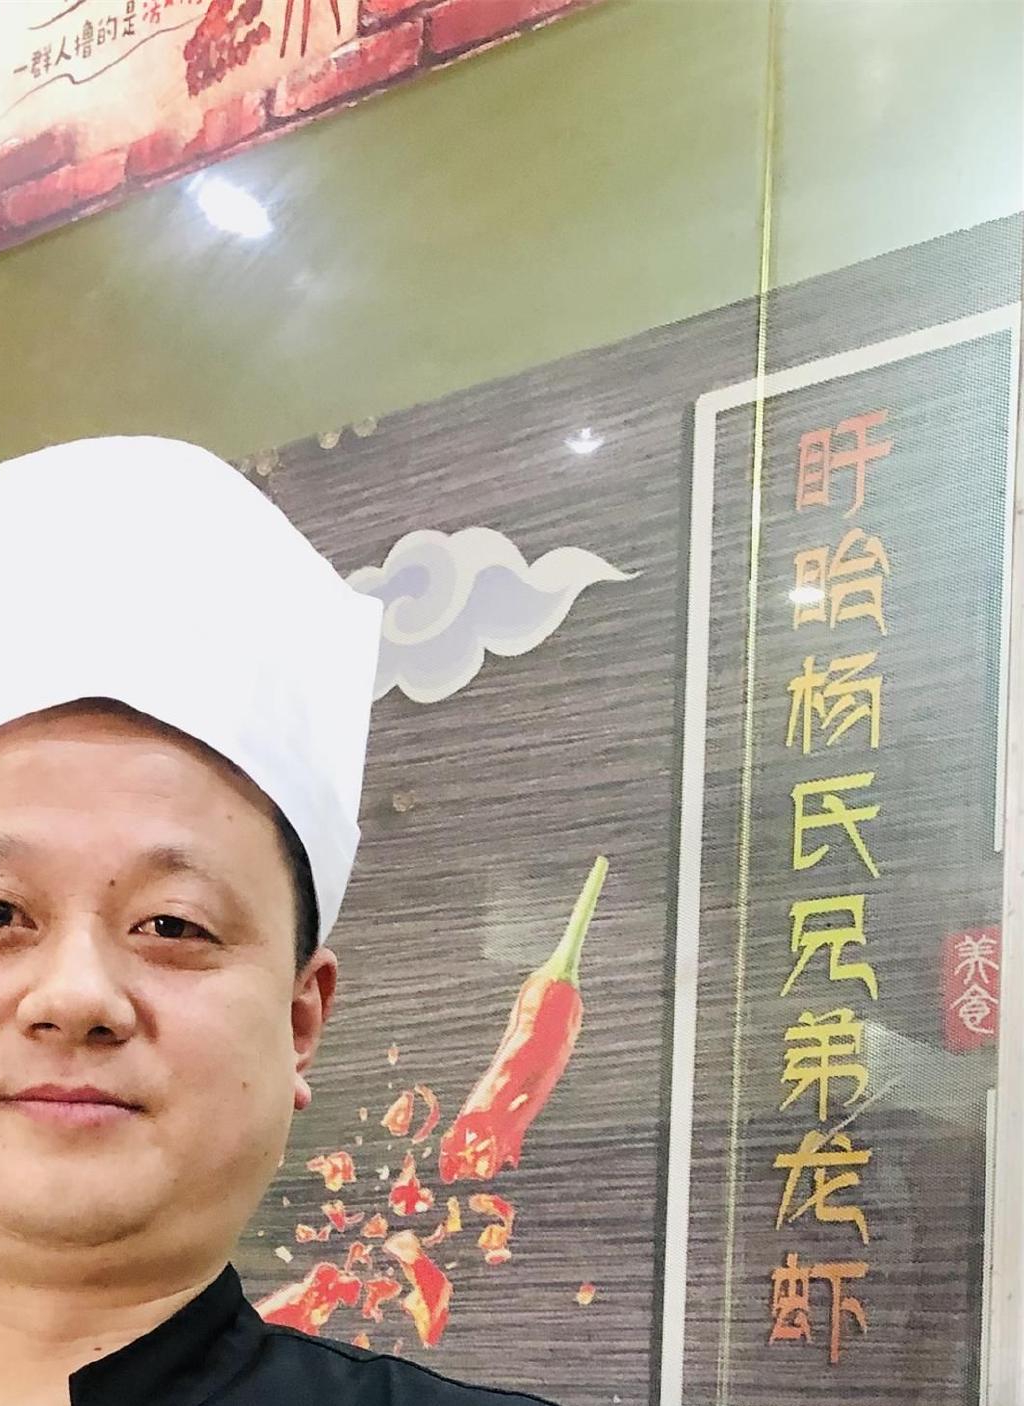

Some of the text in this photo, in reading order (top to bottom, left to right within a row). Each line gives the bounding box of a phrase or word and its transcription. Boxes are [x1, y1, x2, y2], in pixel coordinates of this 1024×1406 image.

[769, 409, 895, 1364] 盱眙杨氏兄弟龙虾
